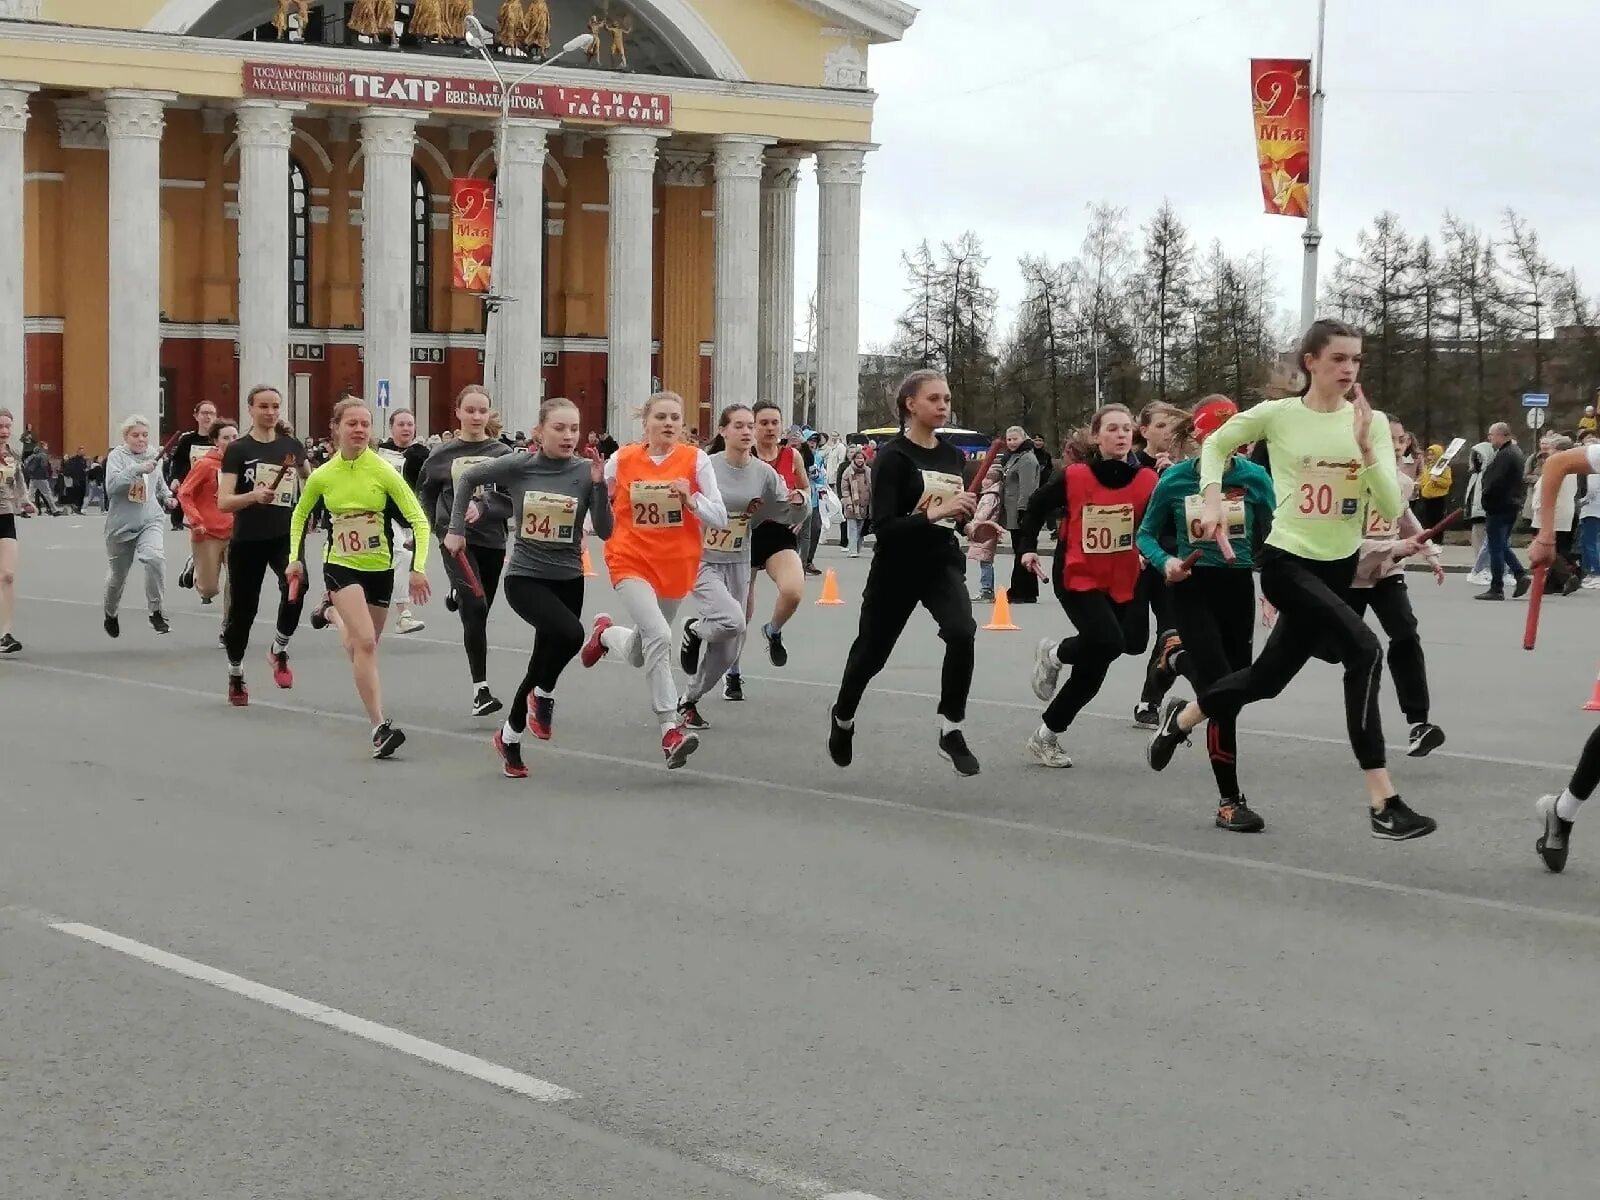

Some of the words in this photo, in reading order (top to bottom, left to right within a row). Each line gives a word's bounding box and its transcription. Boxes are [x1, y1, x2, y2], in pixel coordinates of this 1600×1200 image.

[252, 67, 346, 84] ГОСУДАРСТВЕННЫЙ
[349, 74, 441, 101] ТЕАТР
[1255, 70, 1299, 118] 9
[612, 93, 659, 108] МАЯ
[568, 103, 664, 121] ГАСТРОЛИ
[1260, 124, 1306, 141] Мая
[455, 188, 486, 220] 9
[1299, 483, 1332, 515] 30
[634, 503, 660, 525] 28
[525, 513, 551, 538] 34
[338, 530, 361, 552] 18
[706, 527, 732, 547] 37
[1086, 527, 1112, 549] 50
